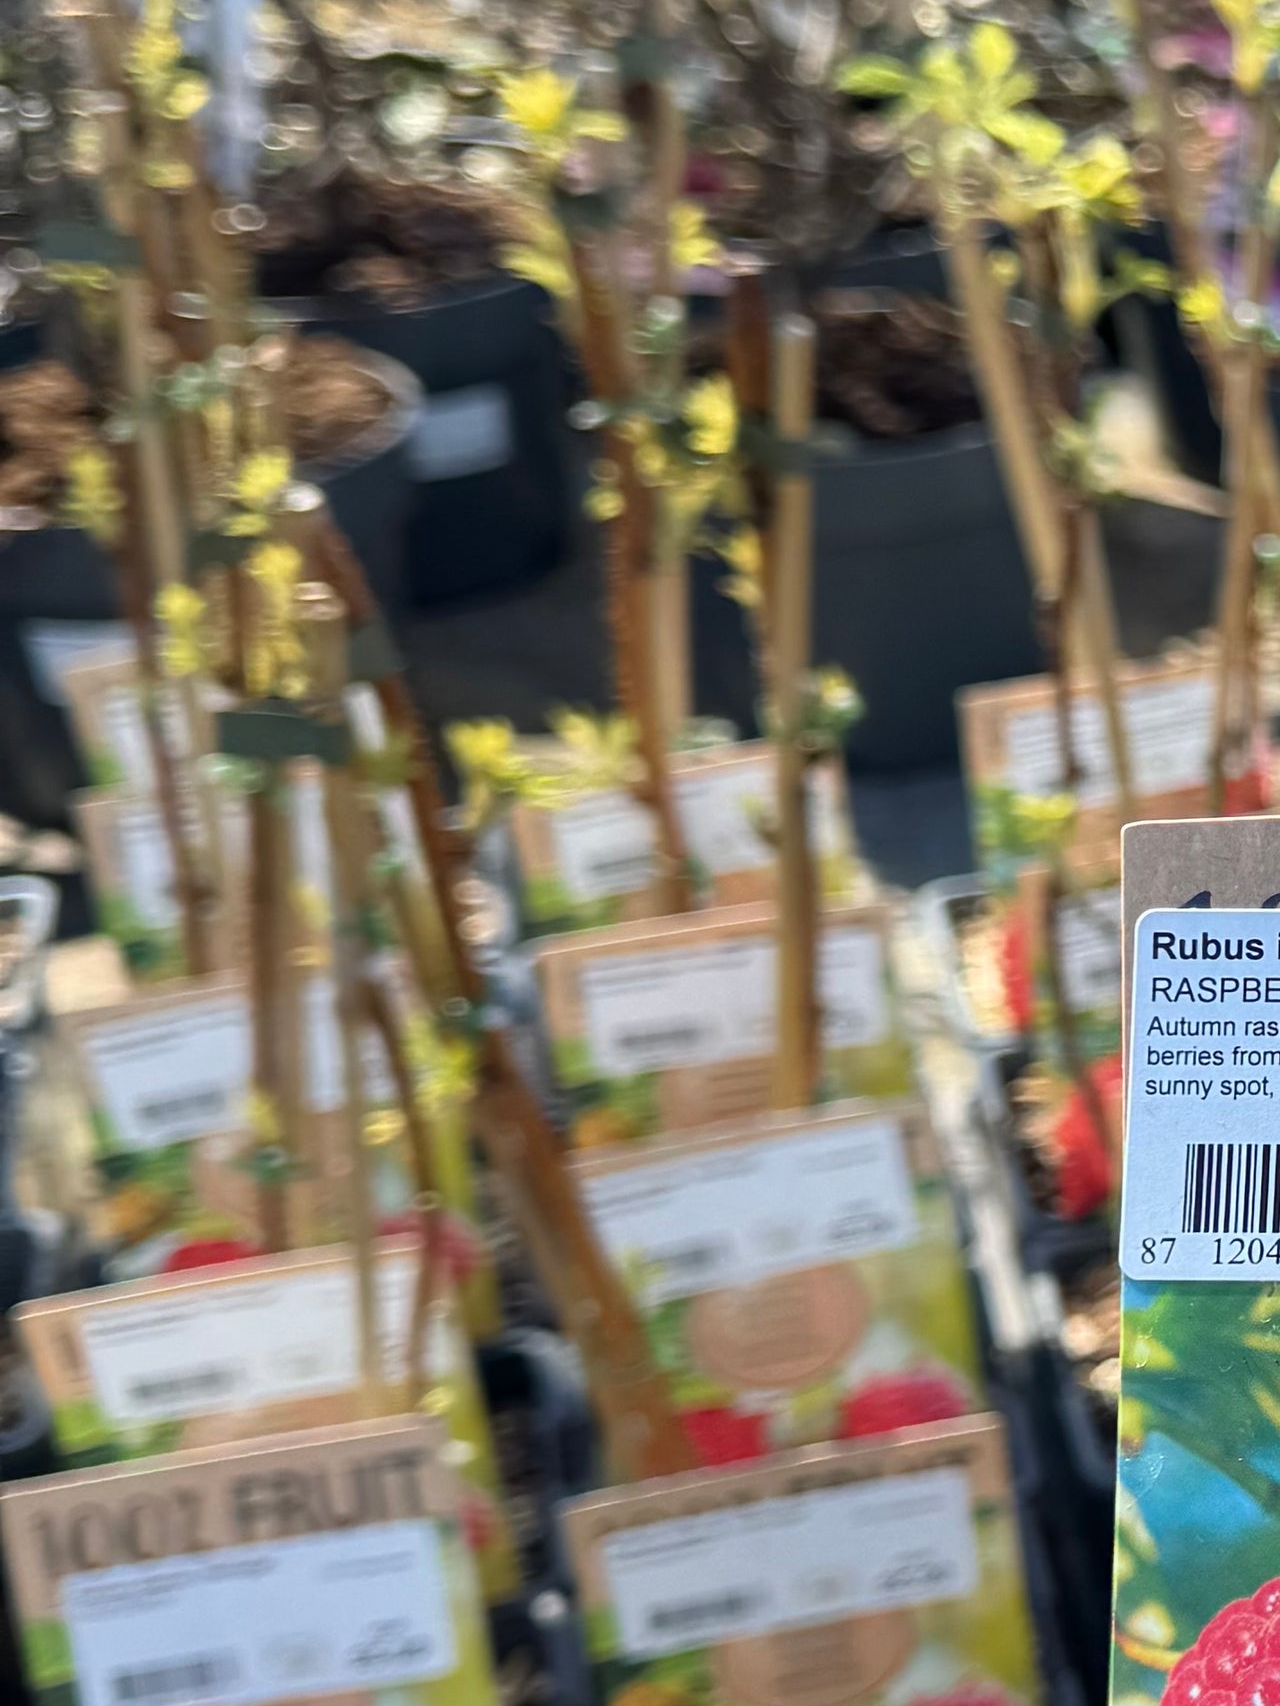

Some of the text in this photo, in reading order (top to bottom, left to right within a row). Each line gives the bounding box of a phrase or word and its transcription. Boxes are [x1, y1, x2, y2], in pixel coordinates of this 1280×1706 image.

[1151, 932, 1264, 961] Rubus
[1147, 1016, 1236, 1037] Autumn
[1147, 1046, 1224, 1066] berries
[1145, 1078, 1213, 1100] sunny
[1220, 1077, 1274, 1100] spot,
[1140, 1237, 1176, 1264] 87
